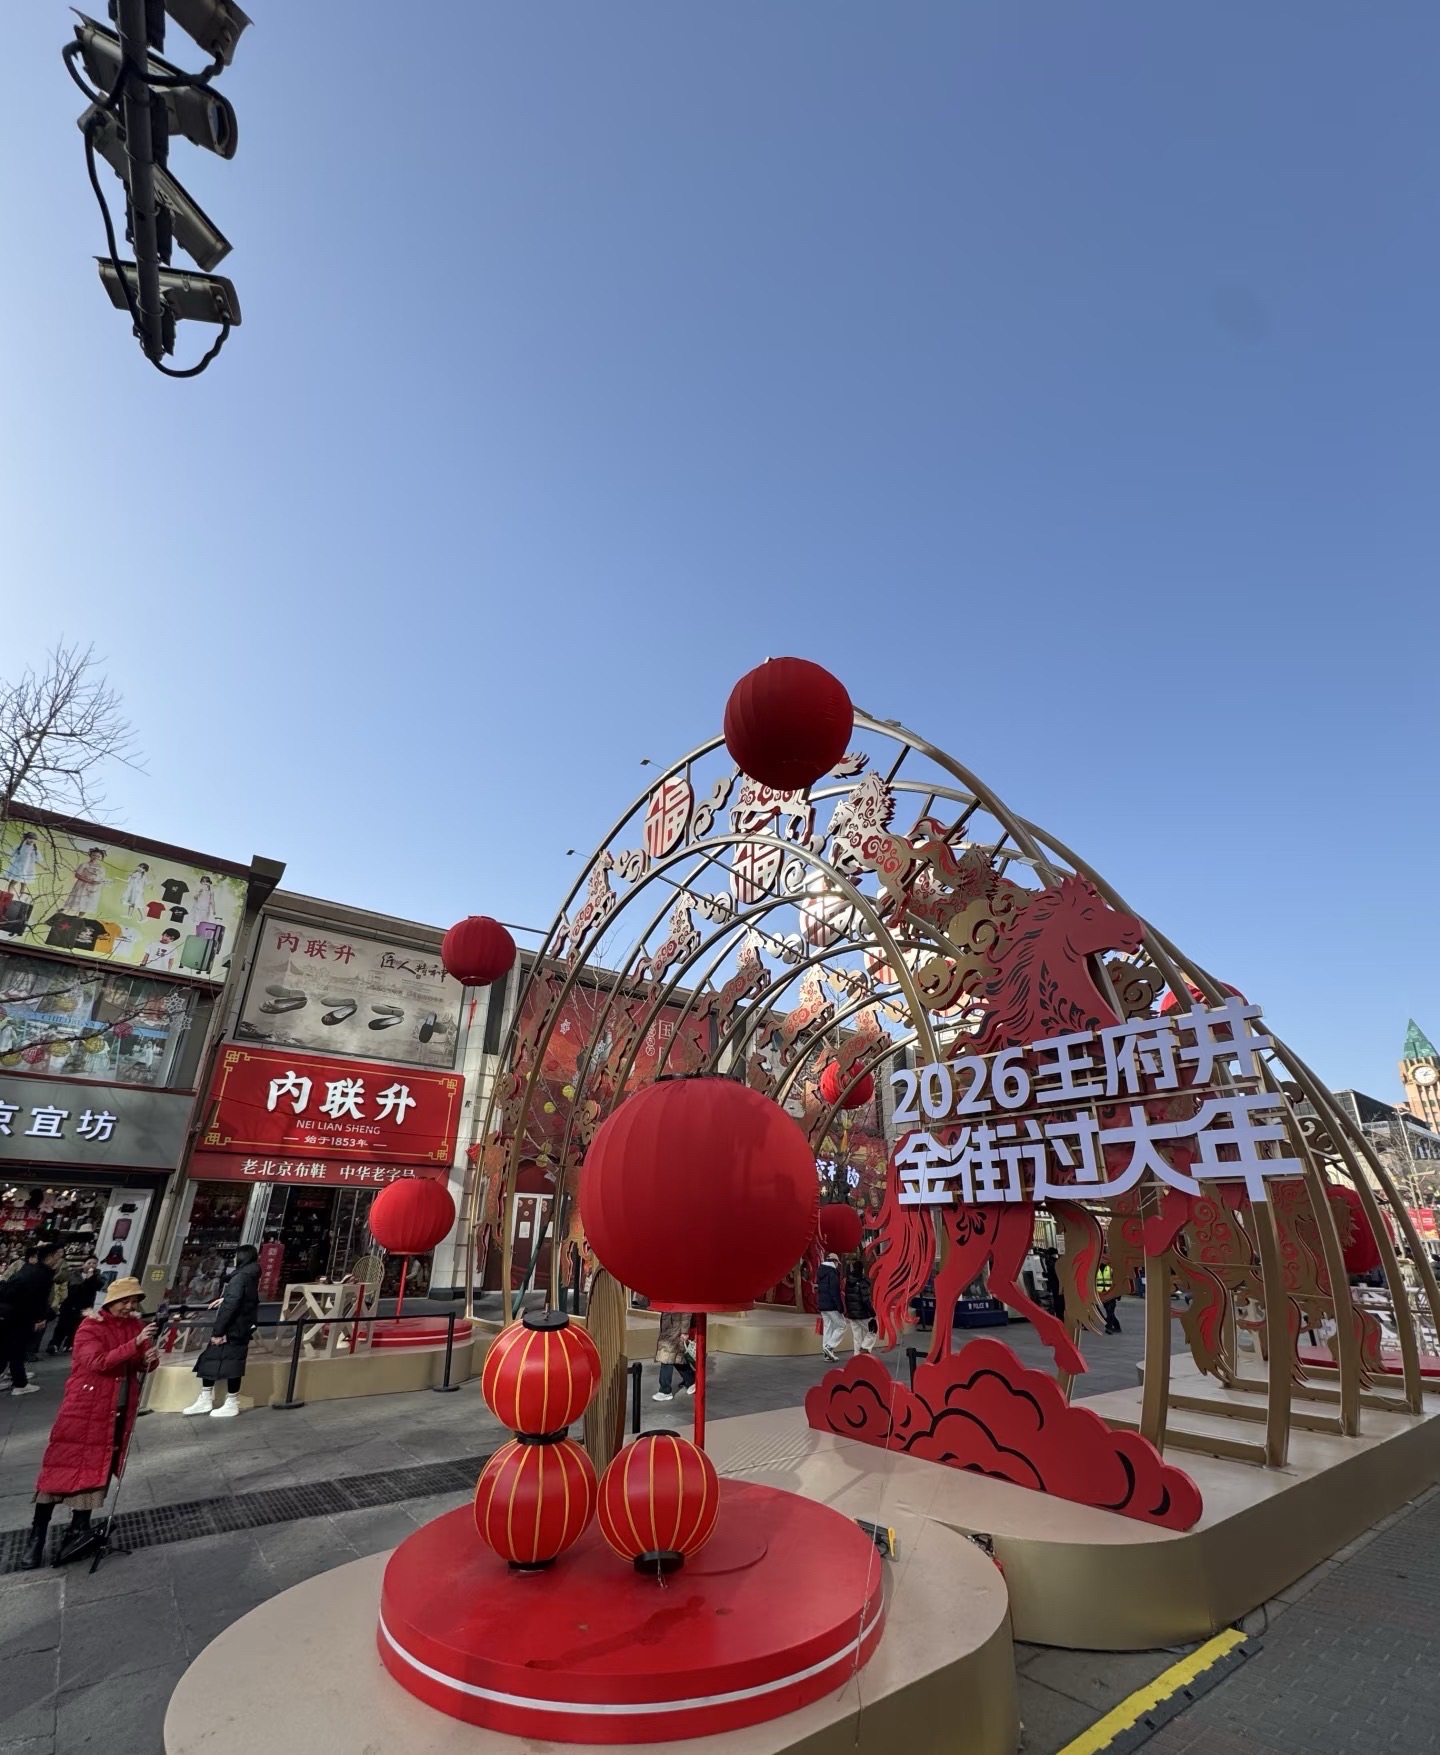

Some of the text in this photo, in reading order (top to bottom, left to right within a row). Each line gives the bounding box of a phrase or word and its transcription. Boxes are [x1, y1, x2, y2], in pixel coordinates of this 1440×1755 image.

[276, 932, 356, 965] 内联升
[889, 996, 1274, 1124] 2026王府井
[266, 1070, 416, 1125] 内联升
[296, 1119, 381, 1135] NEI LIAN SHENG
[304, 1135, 368, 1148] 始于1853年
[894, 1093, 1305, 1204] 金街过大年
[240, 1159, 327, 1180] 老北京布鞋
